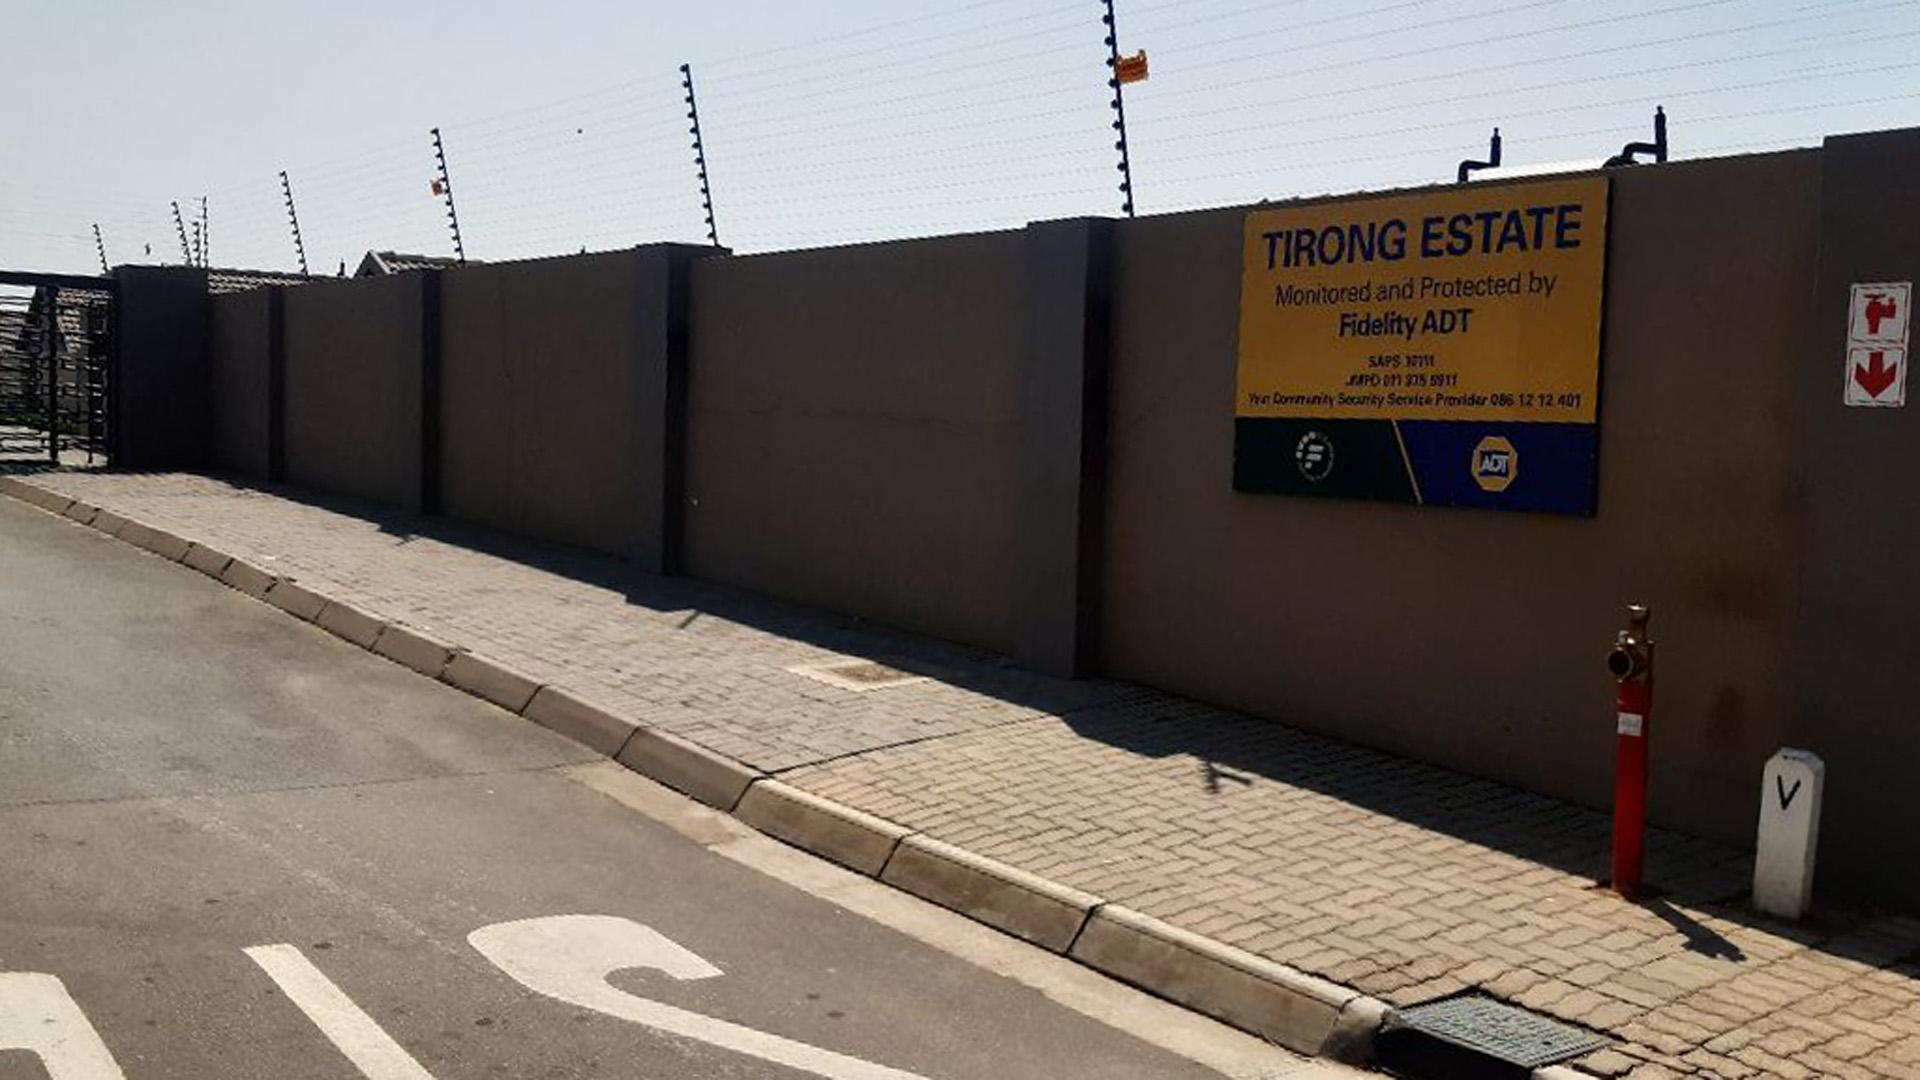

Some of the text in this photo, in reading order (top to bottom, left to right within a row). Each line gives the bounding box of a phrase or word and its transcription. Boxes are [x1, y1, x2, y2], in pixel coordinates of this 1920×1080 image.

[1262, 204, 1583, 270] TIRONG ESTATE
[1275, 271, 1557, 307] Monitored and Protected by
[1338, 308, 1473, 340] Fidelity ADT
[1368, 355, 1401, 368] SAPS
[1383, 373, 1402, 387] 011
[1429, 373, 1457, 387] 5911
[1273, 391, 1334, 408] Community
[1337, 391, 1385, 408] Security
[1387, 392, 1433, 407] Service
[1435, 392, 1488, 407] Provider
[1490, 392, 1515, 407] 086
[1518, 393, 1535, 407] 12
[1537, 393, 1554, 407] 12
[1557, 393, 1581, 408] 401
[1480, 452, 1509, 474] ADT
[1777, 774, 1801, 811] V
